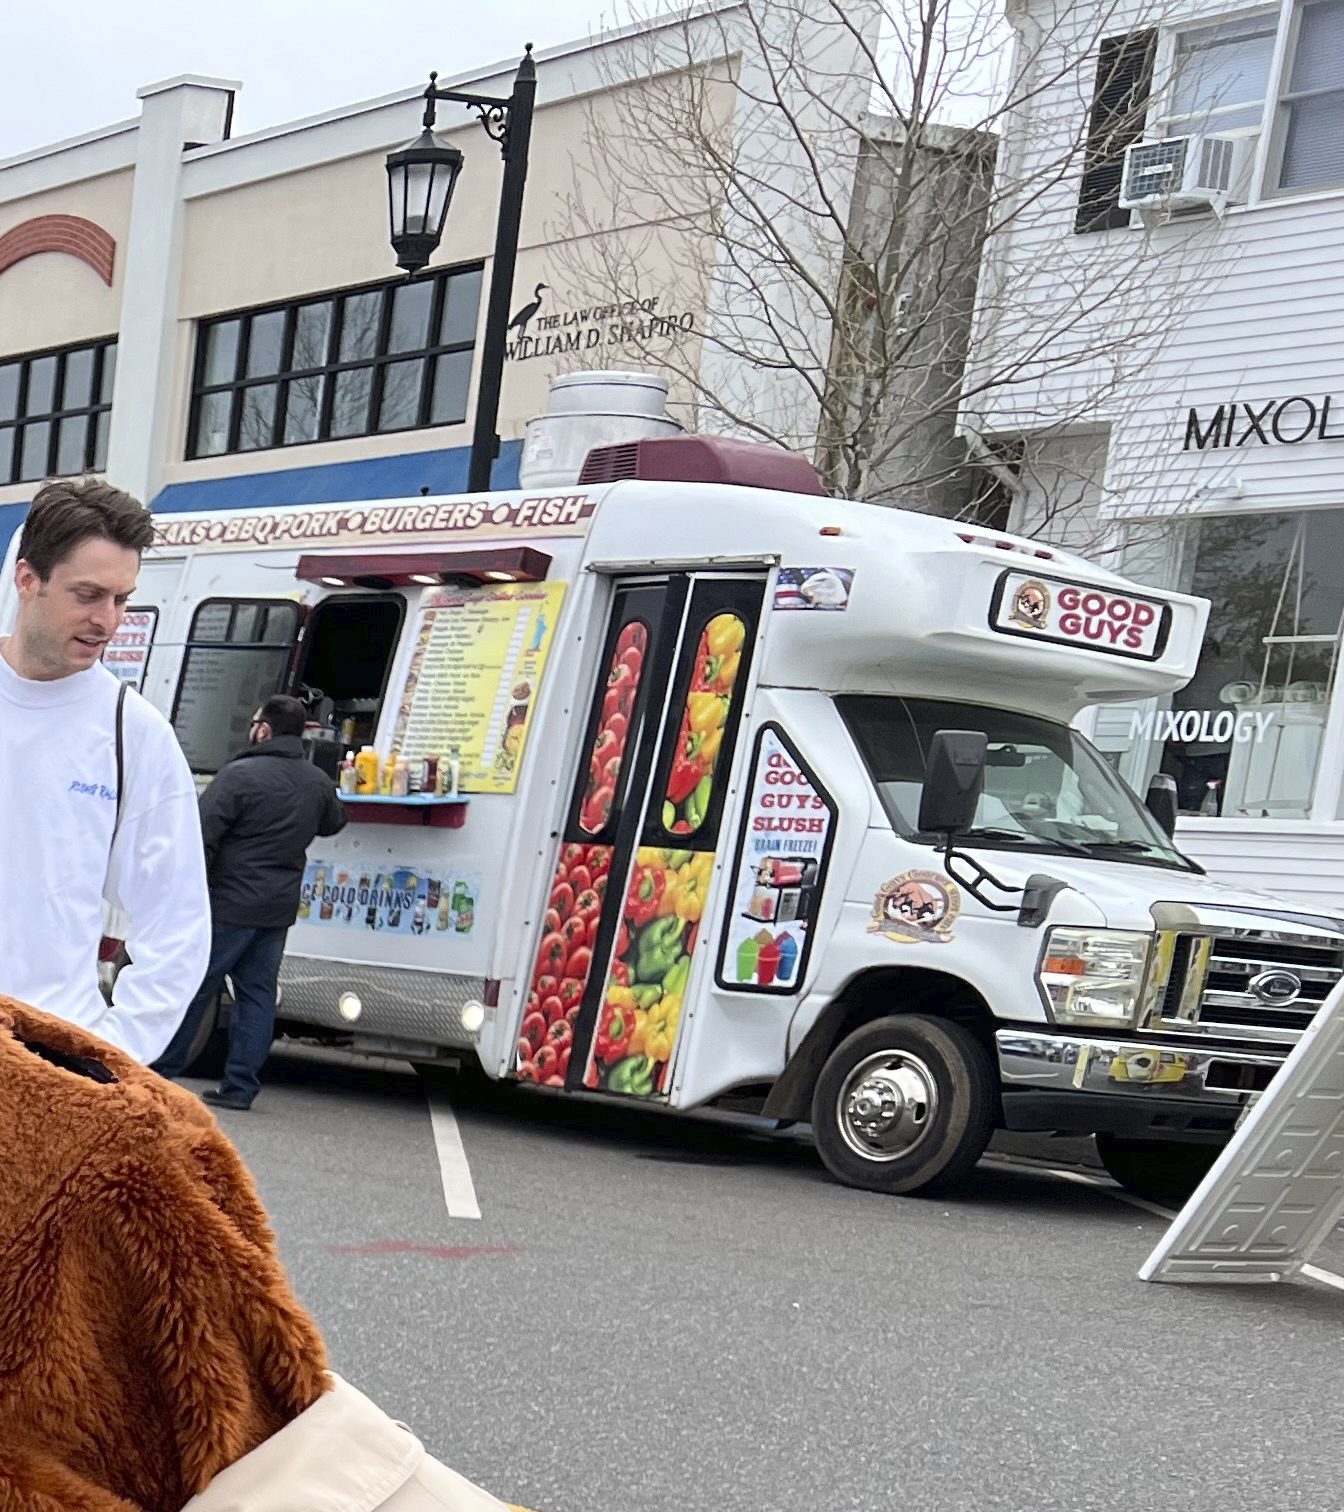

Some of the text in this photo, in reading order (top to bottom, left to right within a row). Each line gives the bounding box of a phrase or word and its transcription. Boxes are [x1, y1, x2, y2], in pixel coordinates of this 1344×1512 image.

[535, 296, 660, 331] THE LAW OFFICE OF
[504, 312, 694, 361] WILLIAM D. SHAPIRO
[151, 495, 588, 547] EAKS BBQ PORK BURGERS FISH
[1057, 587, 1155, 627] GOOD
[1058, 612, 1144, 649] GUYS
[1128, 709, 1275, 743] MIXOLOGY
[765, 770, 811, 786] GOO
[760, 793, 824, 810] GUYS
[753, 816, 825, 833] SLUSH
[301, 883, 318, 902] CE
[321, 885, 356, 905] COLD
